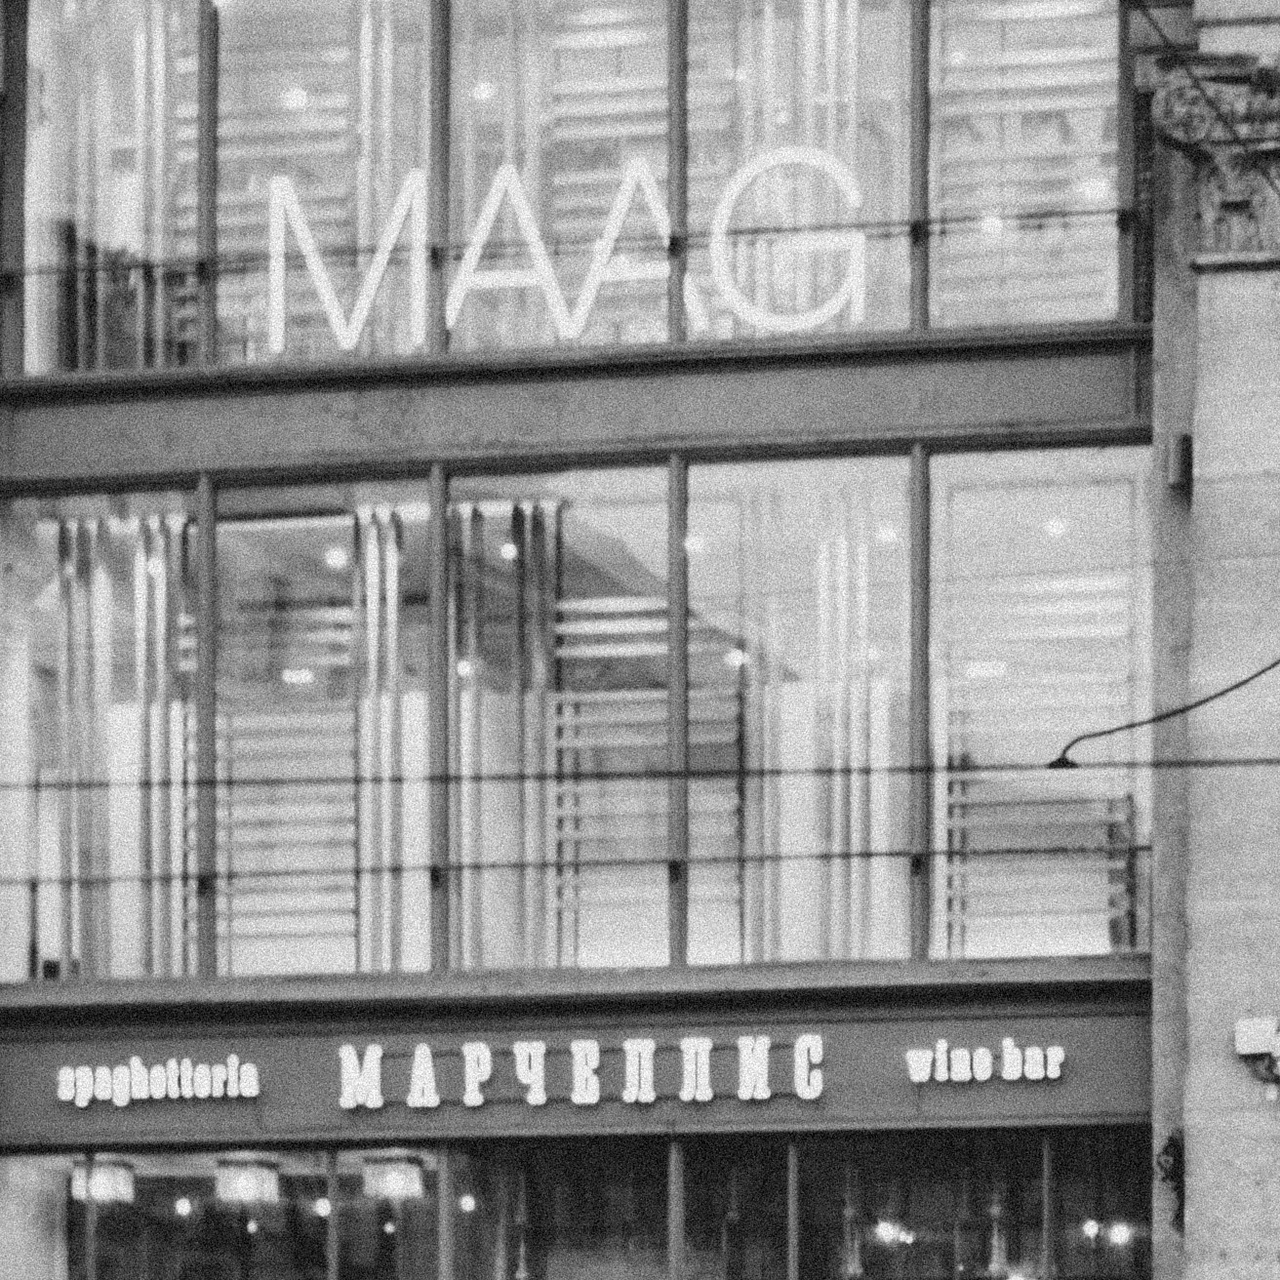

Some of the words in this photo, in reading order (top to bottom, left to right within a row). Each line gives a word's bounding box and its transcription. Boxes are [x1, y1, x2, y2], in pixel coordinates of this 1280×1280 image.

[266, 146, 866, 356] MAAG
[56, 1053, 260, 1108] spaghetteria
[338, 1033, 824, 1109] МАРЧЕЛЛИС
[905, 1038, 993, 1083] vino
[1001, 1036, 1066, 1081] bar
